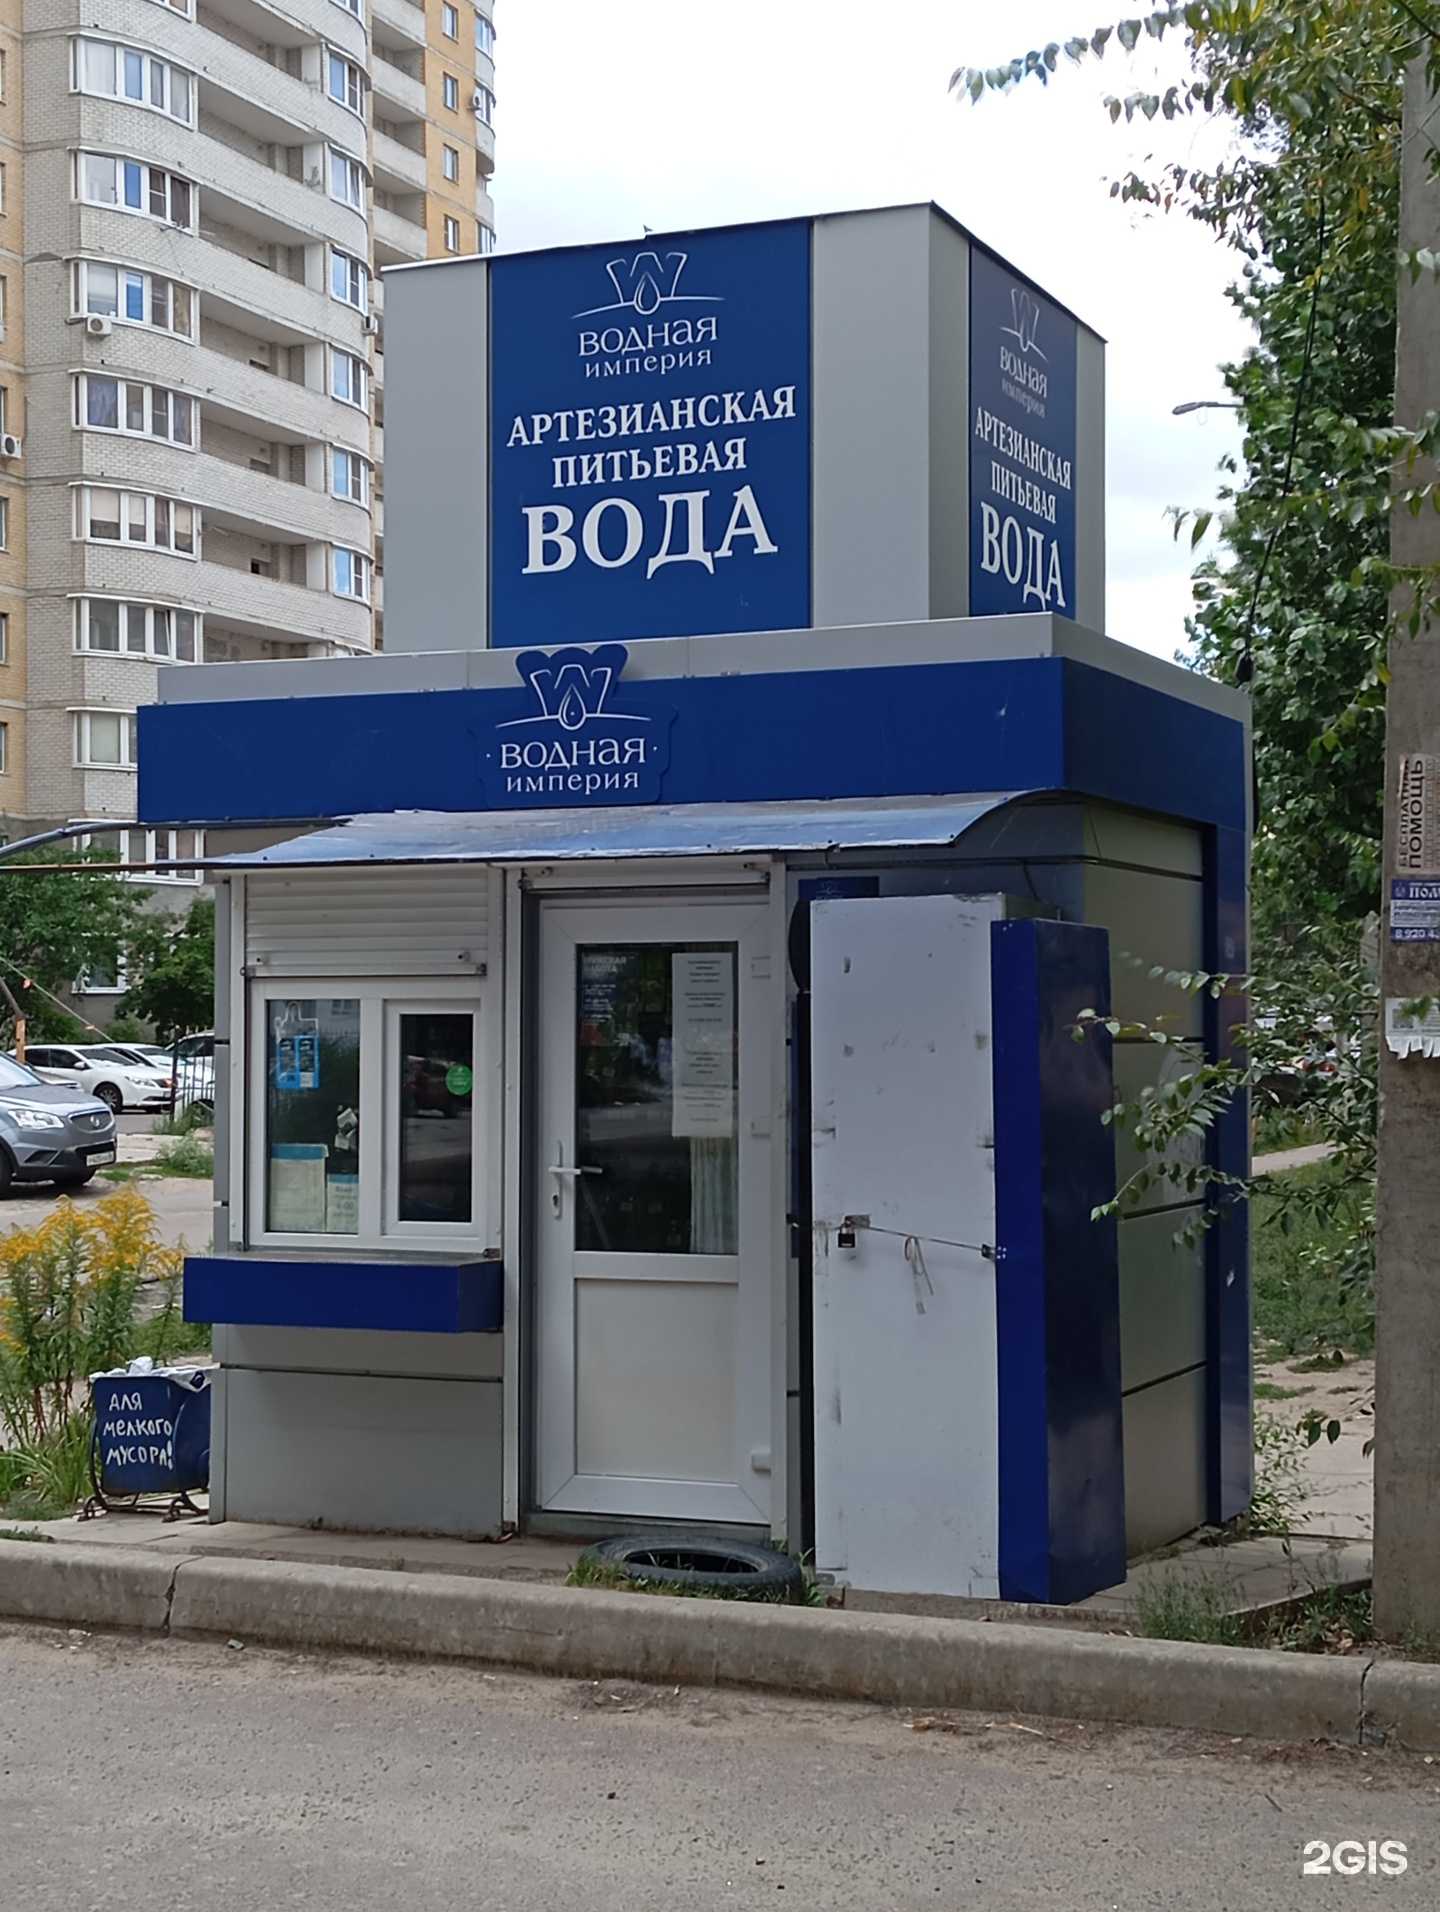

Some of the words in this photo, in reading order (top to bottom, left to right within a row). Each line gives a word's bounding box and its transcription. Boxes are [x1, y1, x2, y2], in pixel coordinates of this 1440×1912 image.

[585, 349, 712, 378] империя
[507, 386, 796, 447] АРТЕЗИАНСКАЯ
[552, 438, 747, 488] ПИТЬЕВАЯ
[975, 407, 1072, 490] АРТЕЗИАНСКАЯ
[991, 461, 1057, 524] ПИТЬЕВАЯ
[522, 485, 778, 579] ВОДА
[980, 501, 1067, 611] ВОДА
[507, 772, 639, 795] империя
[1409, 760, 1424, 868] ПОМОЩЬ
